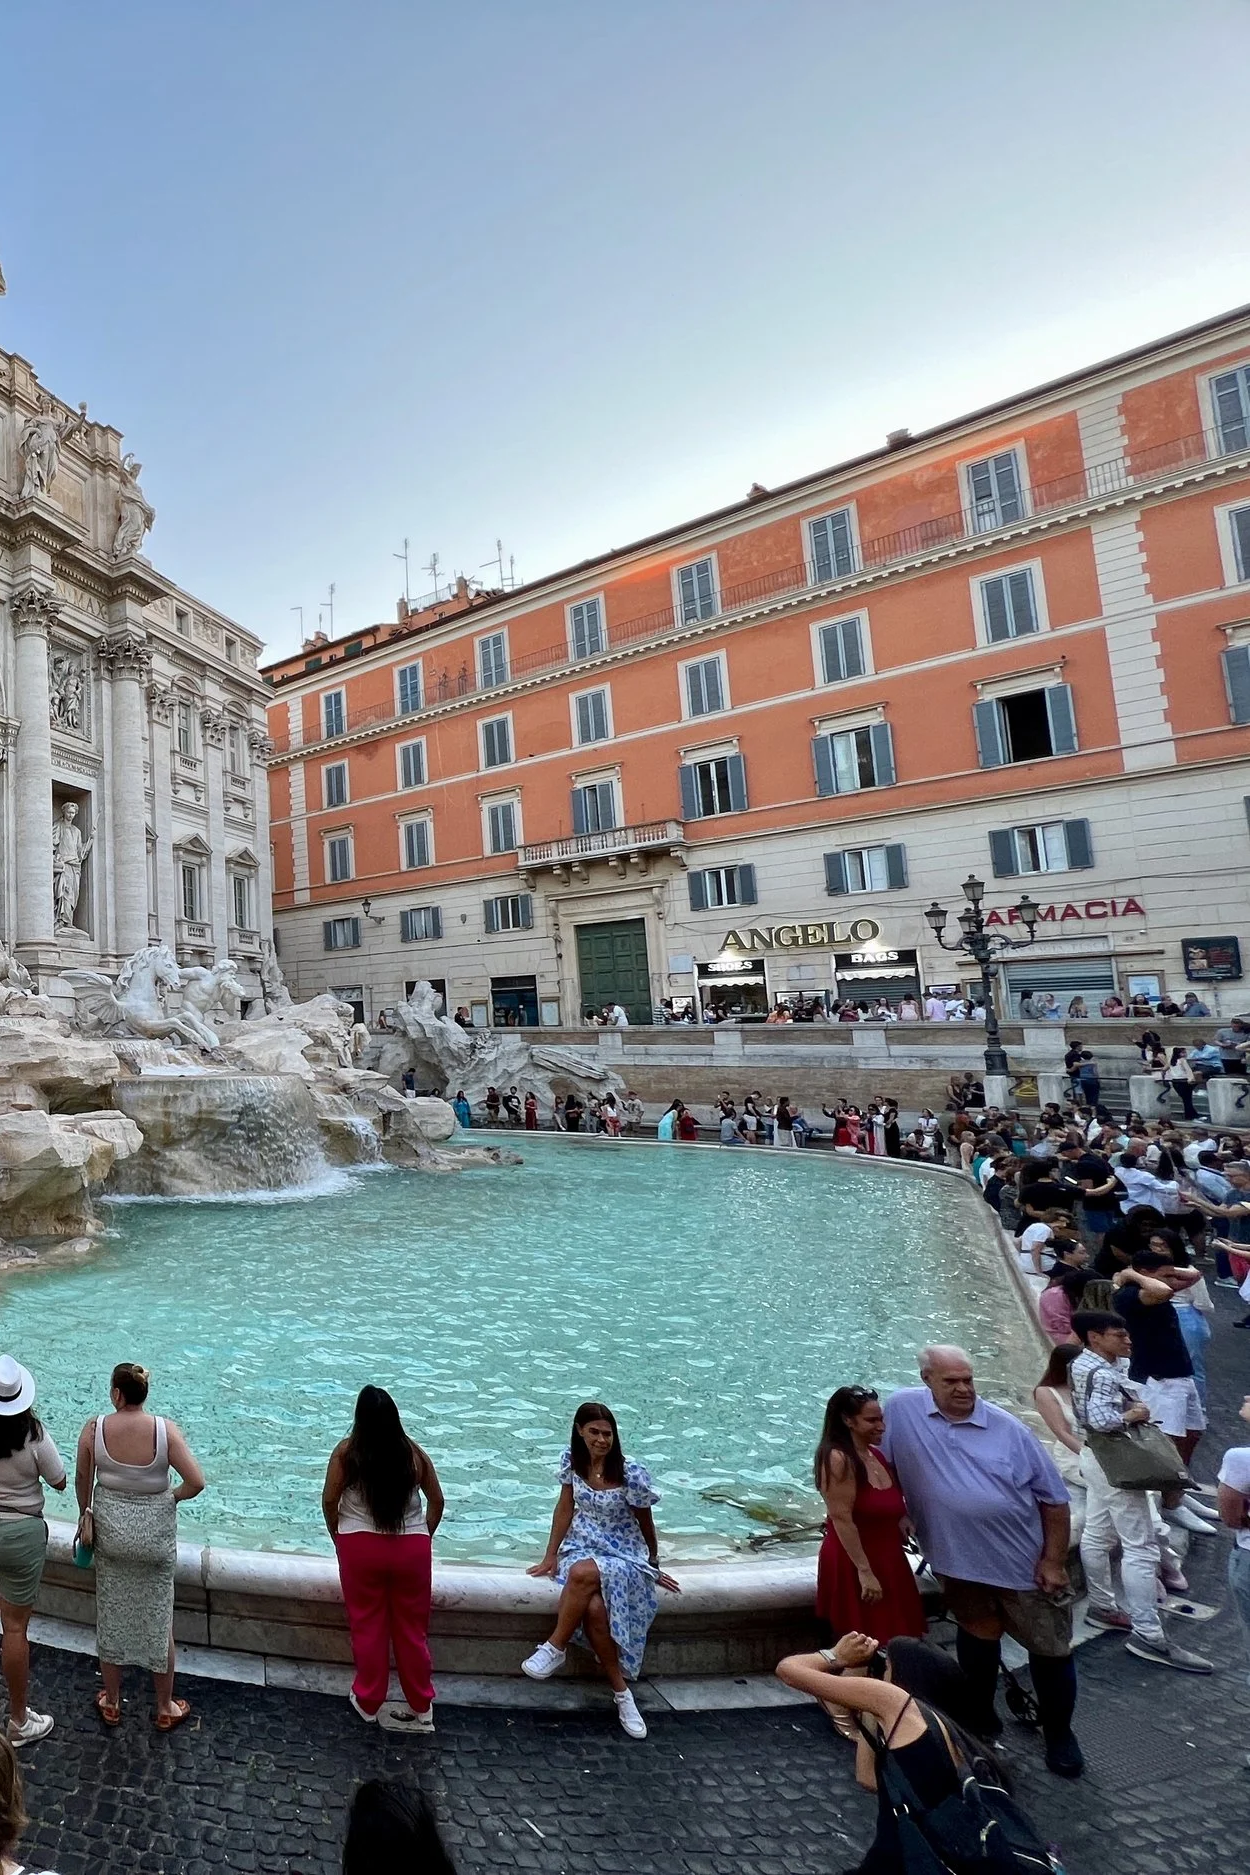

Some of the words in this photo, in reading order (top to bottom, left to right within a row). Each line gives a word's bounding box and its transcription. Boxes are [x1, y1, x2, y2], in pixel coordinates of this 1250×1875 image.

[986, 898, 1145, 926] ARMACIA
[718, 918, 880, 952] ANGELO
[707, 961, 753, 972] SHOES
[851, 951, 899, 963] BAGS
